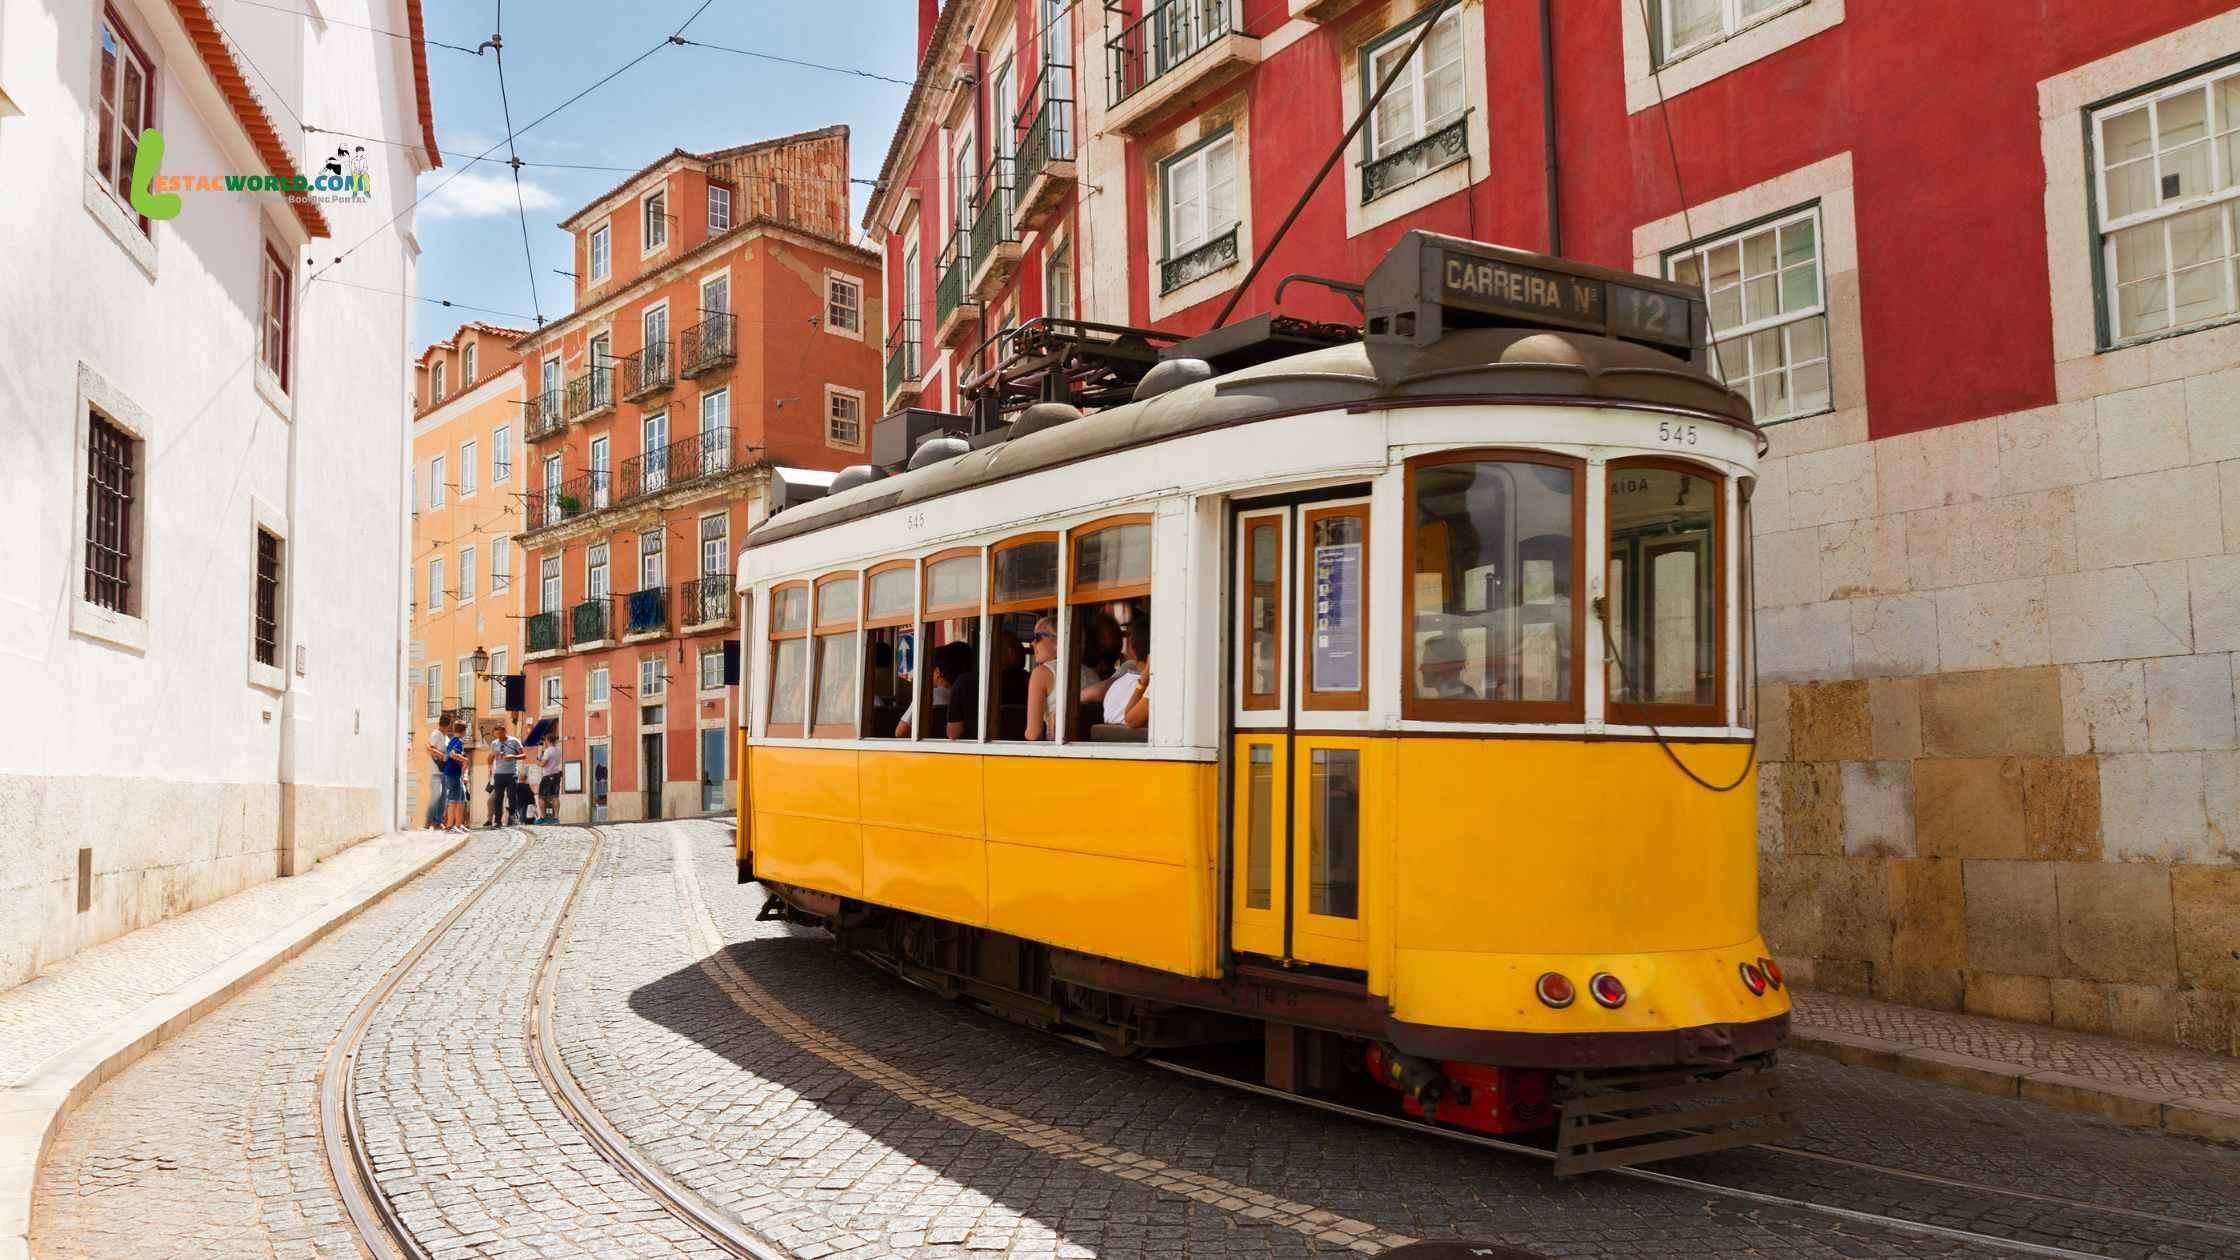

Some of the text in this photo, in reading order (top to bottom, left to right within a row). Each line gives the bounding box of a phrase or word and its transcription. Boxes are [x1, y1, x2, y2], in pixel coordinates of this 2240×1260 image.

[1446, 260, 1561, 309] CARREIRA
[1632, 294, 1665, 332] 12
[1659, 421, 1697, 445] 545
[907, 512, 926, 530] 545
